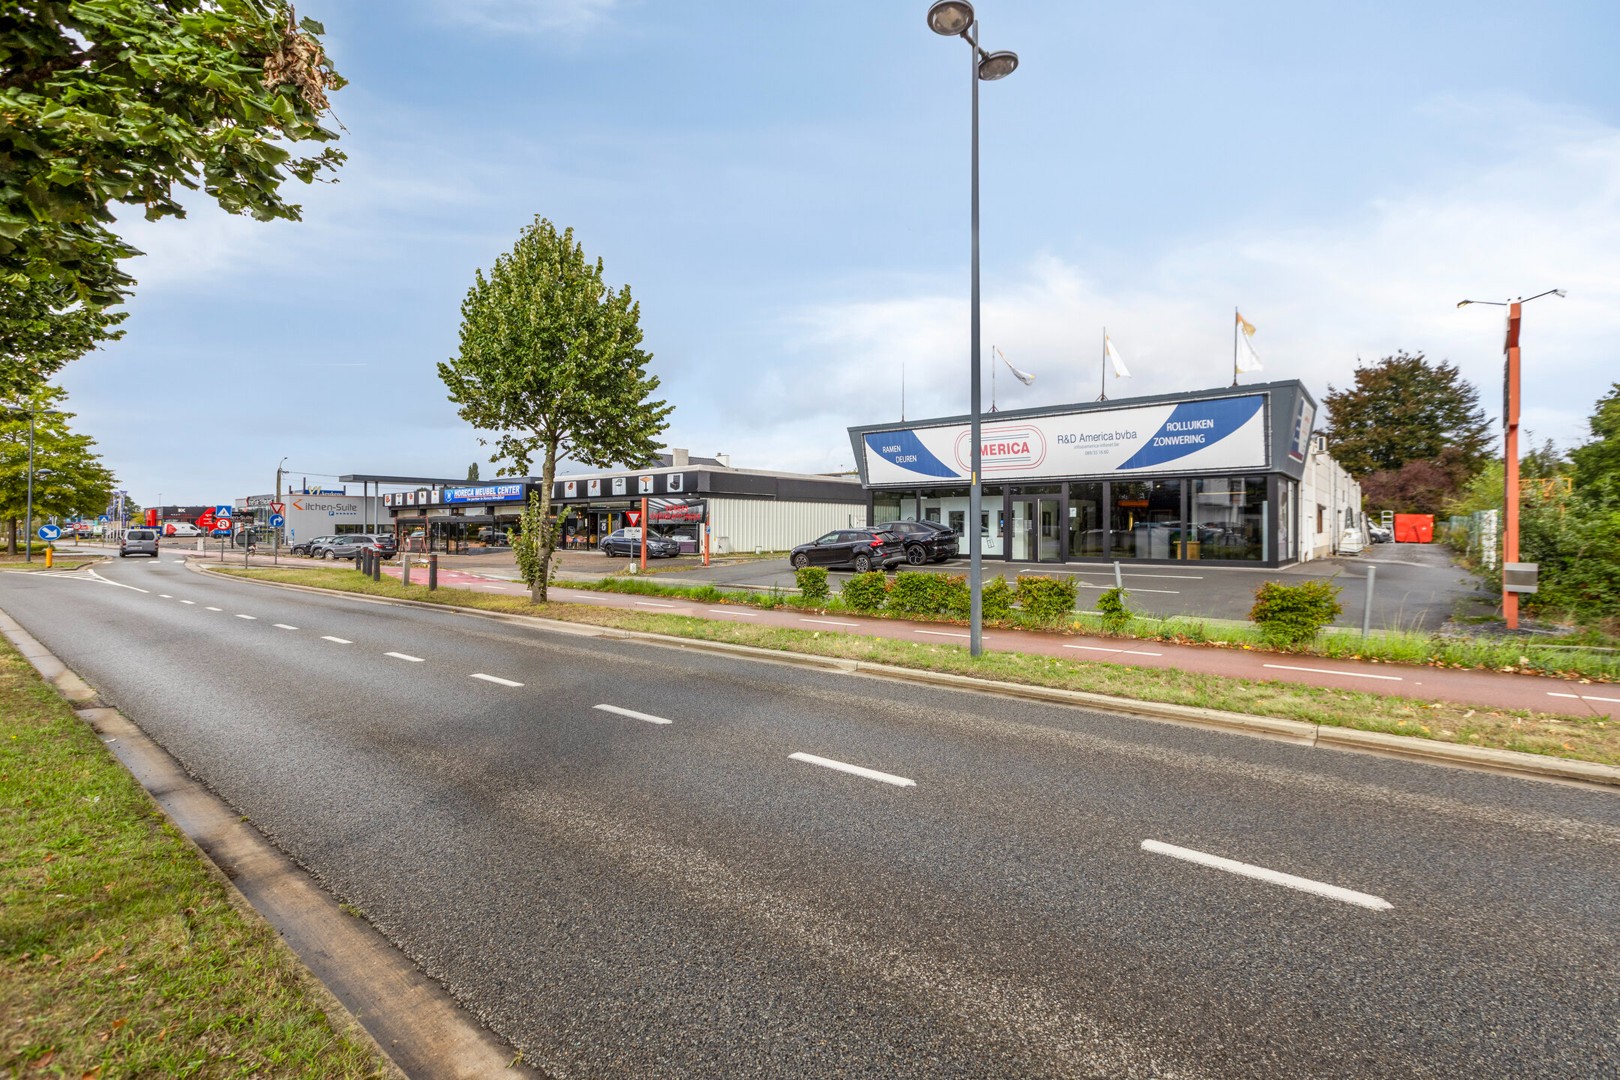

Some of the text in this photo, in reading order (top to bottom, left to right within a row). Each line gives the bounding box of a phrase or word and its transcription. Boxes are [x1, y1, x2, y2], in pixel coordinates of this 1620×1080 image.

[1166, 419, 1214, 431] ROLLUIKEN
[1057, 429, 1138, 444] R&D America bvba
[1153, 434, 1206, 447] ZONWERING
[882, 445, 901, 453] RAMEN
[970, 441, 1030, 457] MERICA
[895, 455, 917, 463] DEUREN
[454, 485, 520, 496] HORECA MEUBEL CENTER
